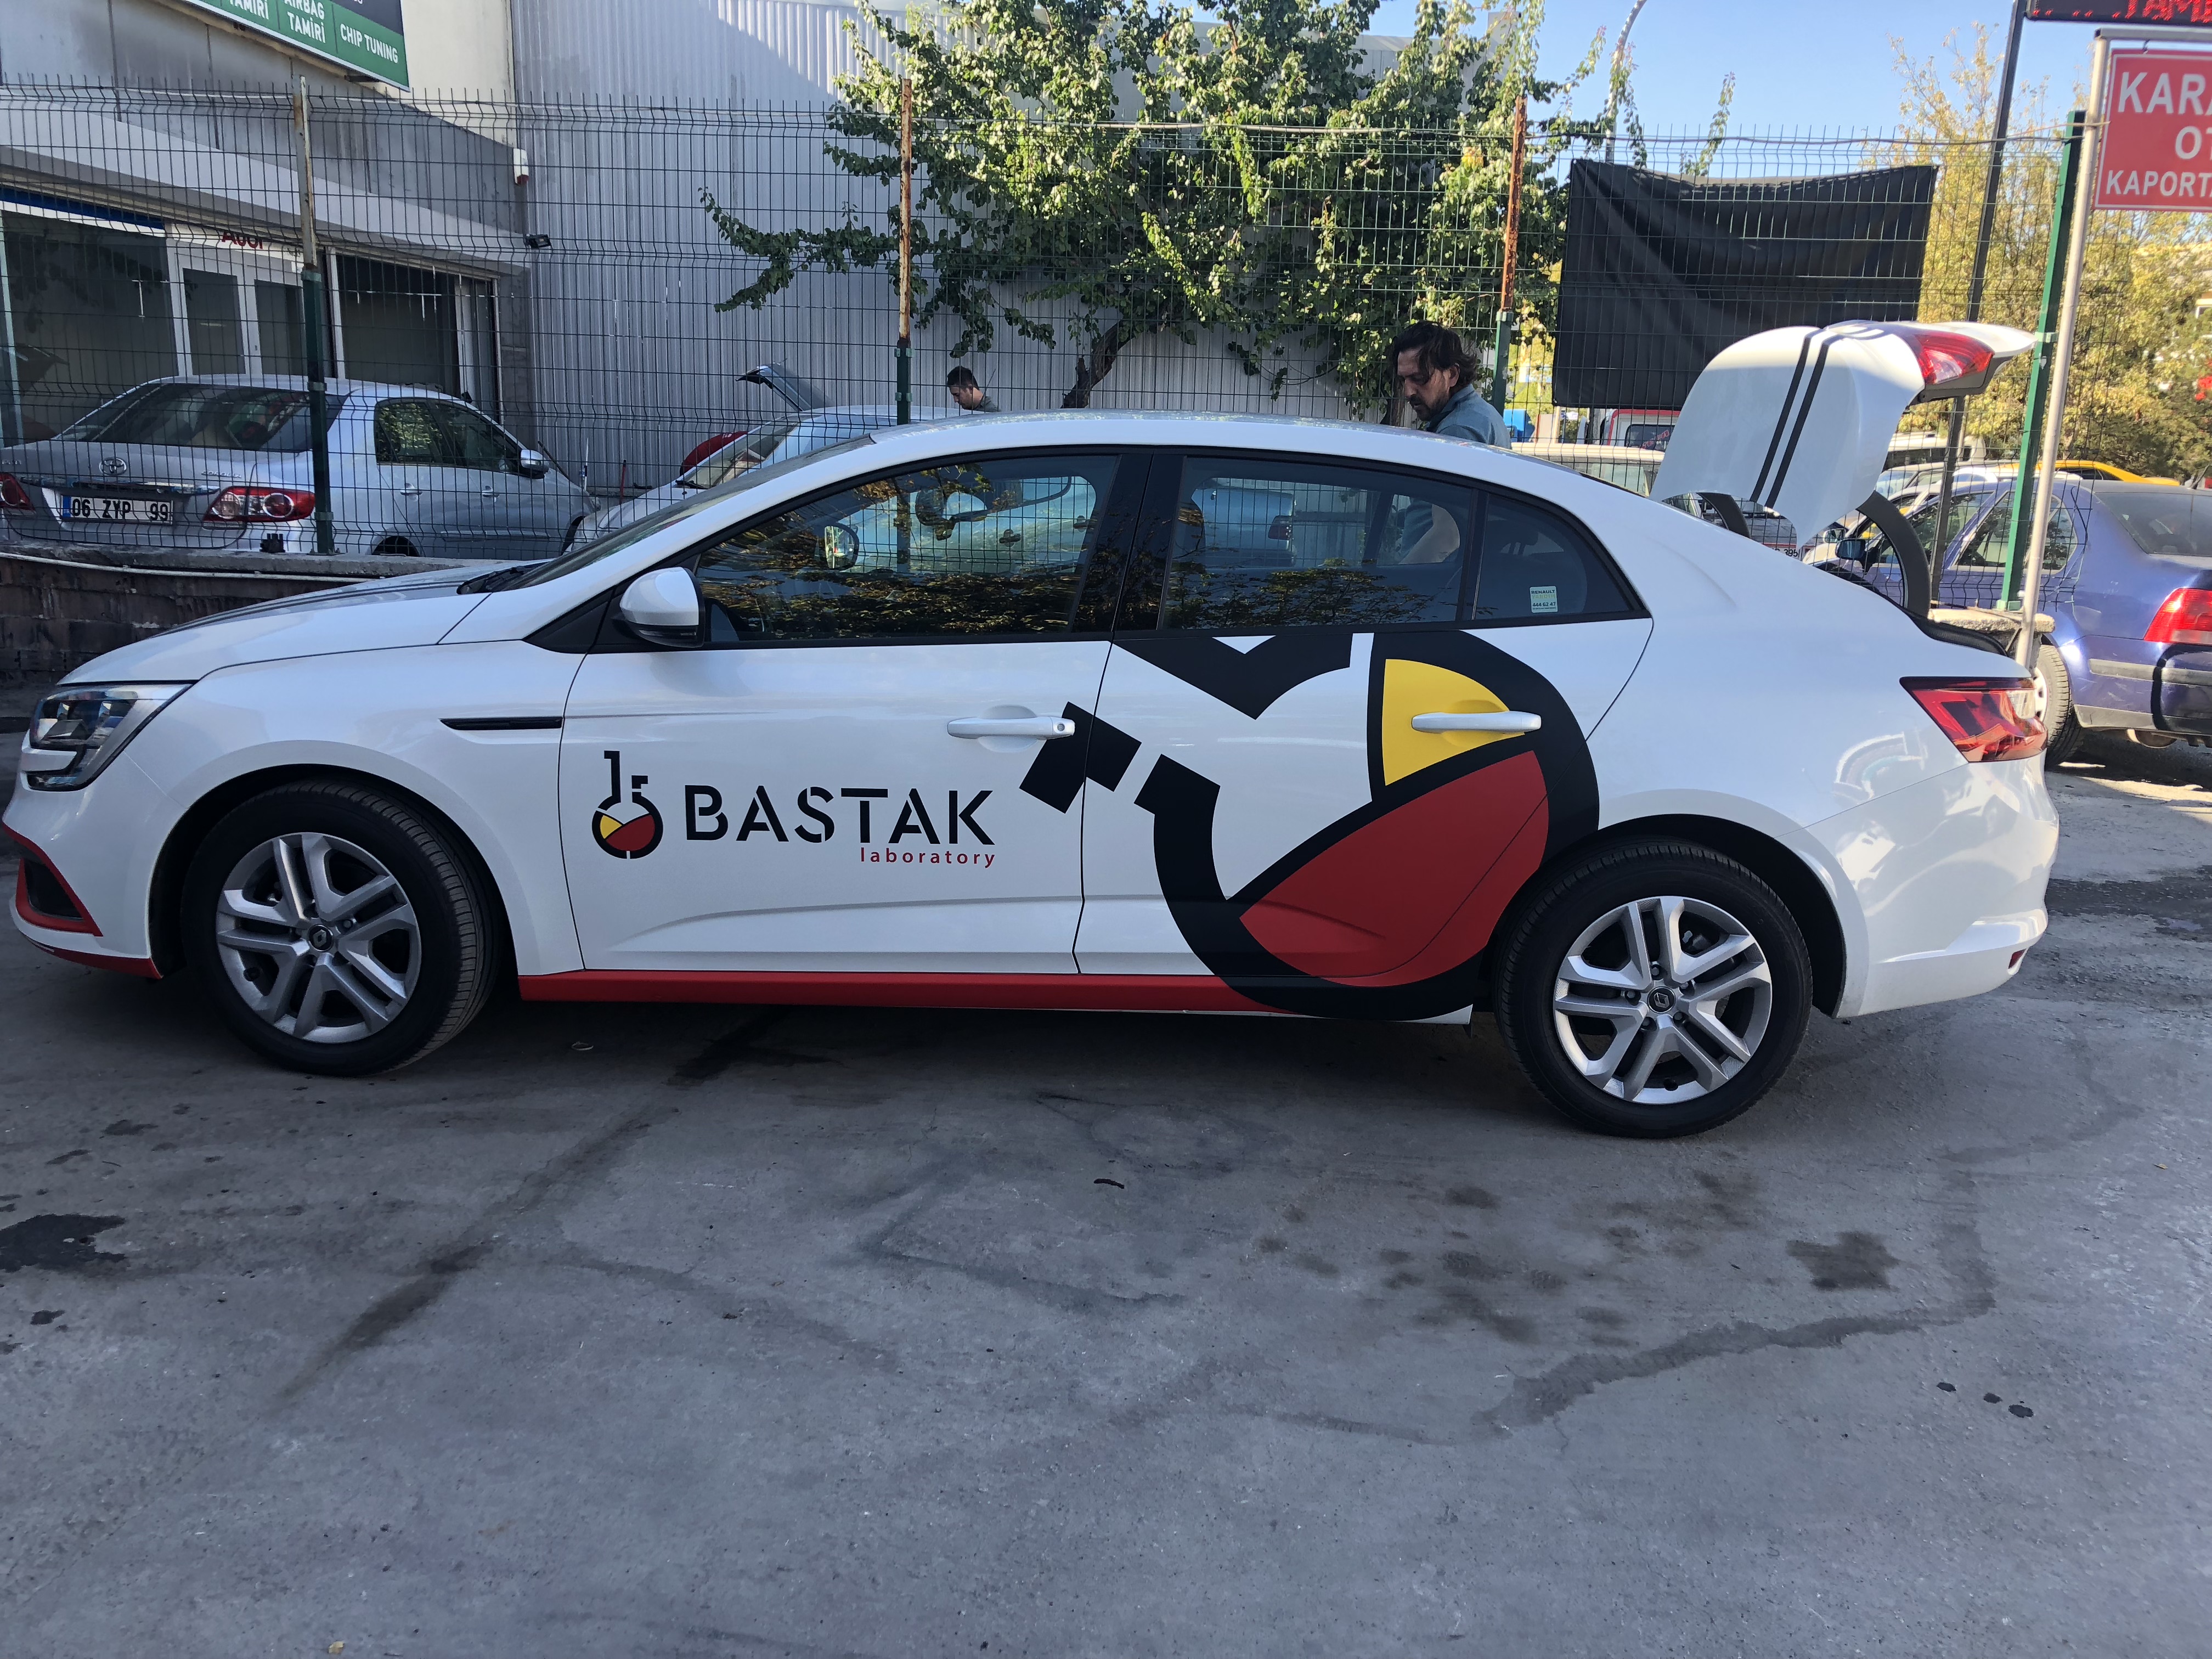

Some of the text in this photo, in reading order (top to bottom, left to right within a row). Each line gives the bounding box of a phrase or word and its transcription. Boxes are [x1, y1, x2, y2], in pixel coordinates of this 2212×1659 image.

[287, 11, 326, 43] TAMİRİ
[340, 23, 399, 64] CHIP TUNING
[2118, 72, 2212, 116] KAR
[2106, 170, 2212, 198] KAPORT
[72, 498, 168, 521] 06 ZYP 99
[685, 785, 995, 845] BASTAK
[860, 847, 995, 868] laboratory
